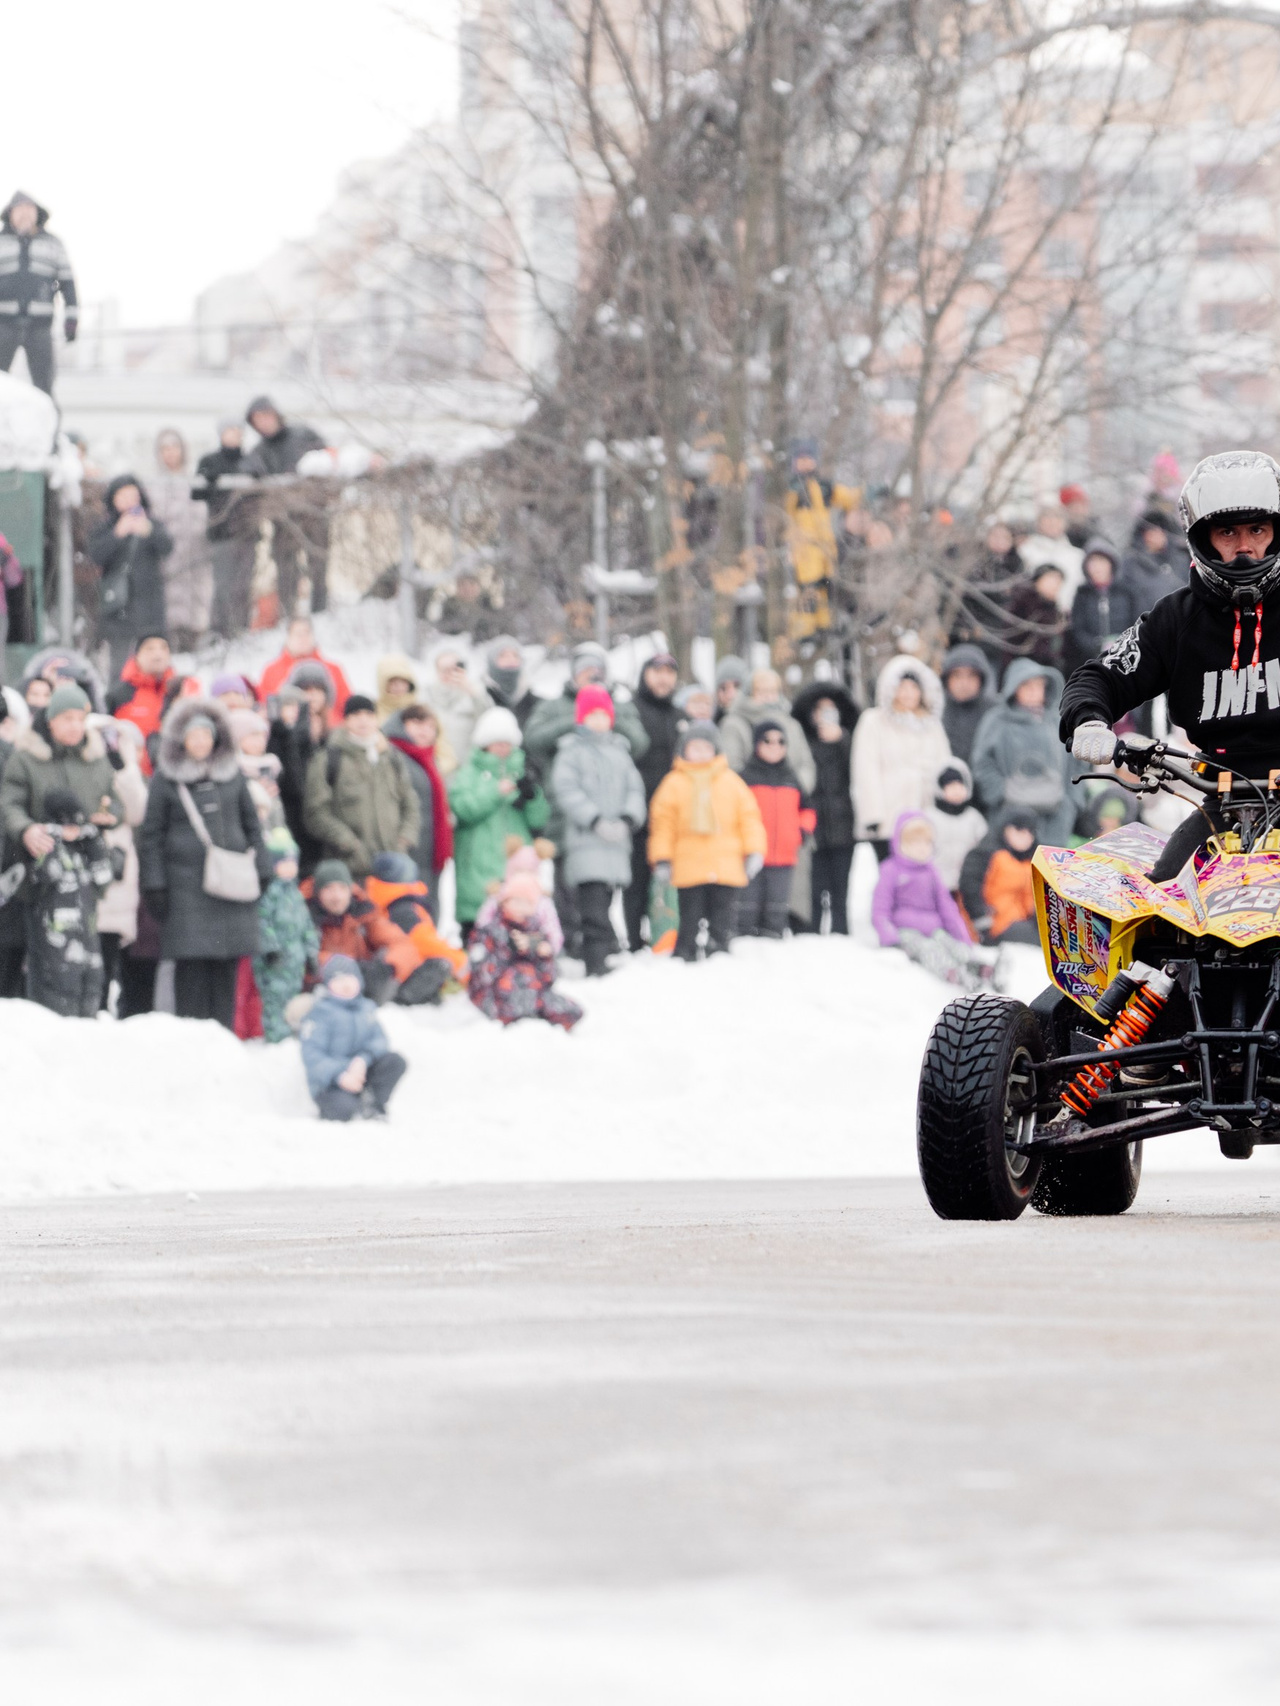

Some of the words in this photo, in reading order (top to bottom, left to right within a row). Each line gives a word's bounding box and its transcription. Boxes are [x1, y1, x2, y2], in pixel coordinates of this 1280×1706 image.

[1048, 888, 1060, 948] STHOUSE
[1065, 901, 1079, 953] AMSOIL
[1056, 962, 1081, 974] FOX
[1072, 983, 1099, 994] GAV
